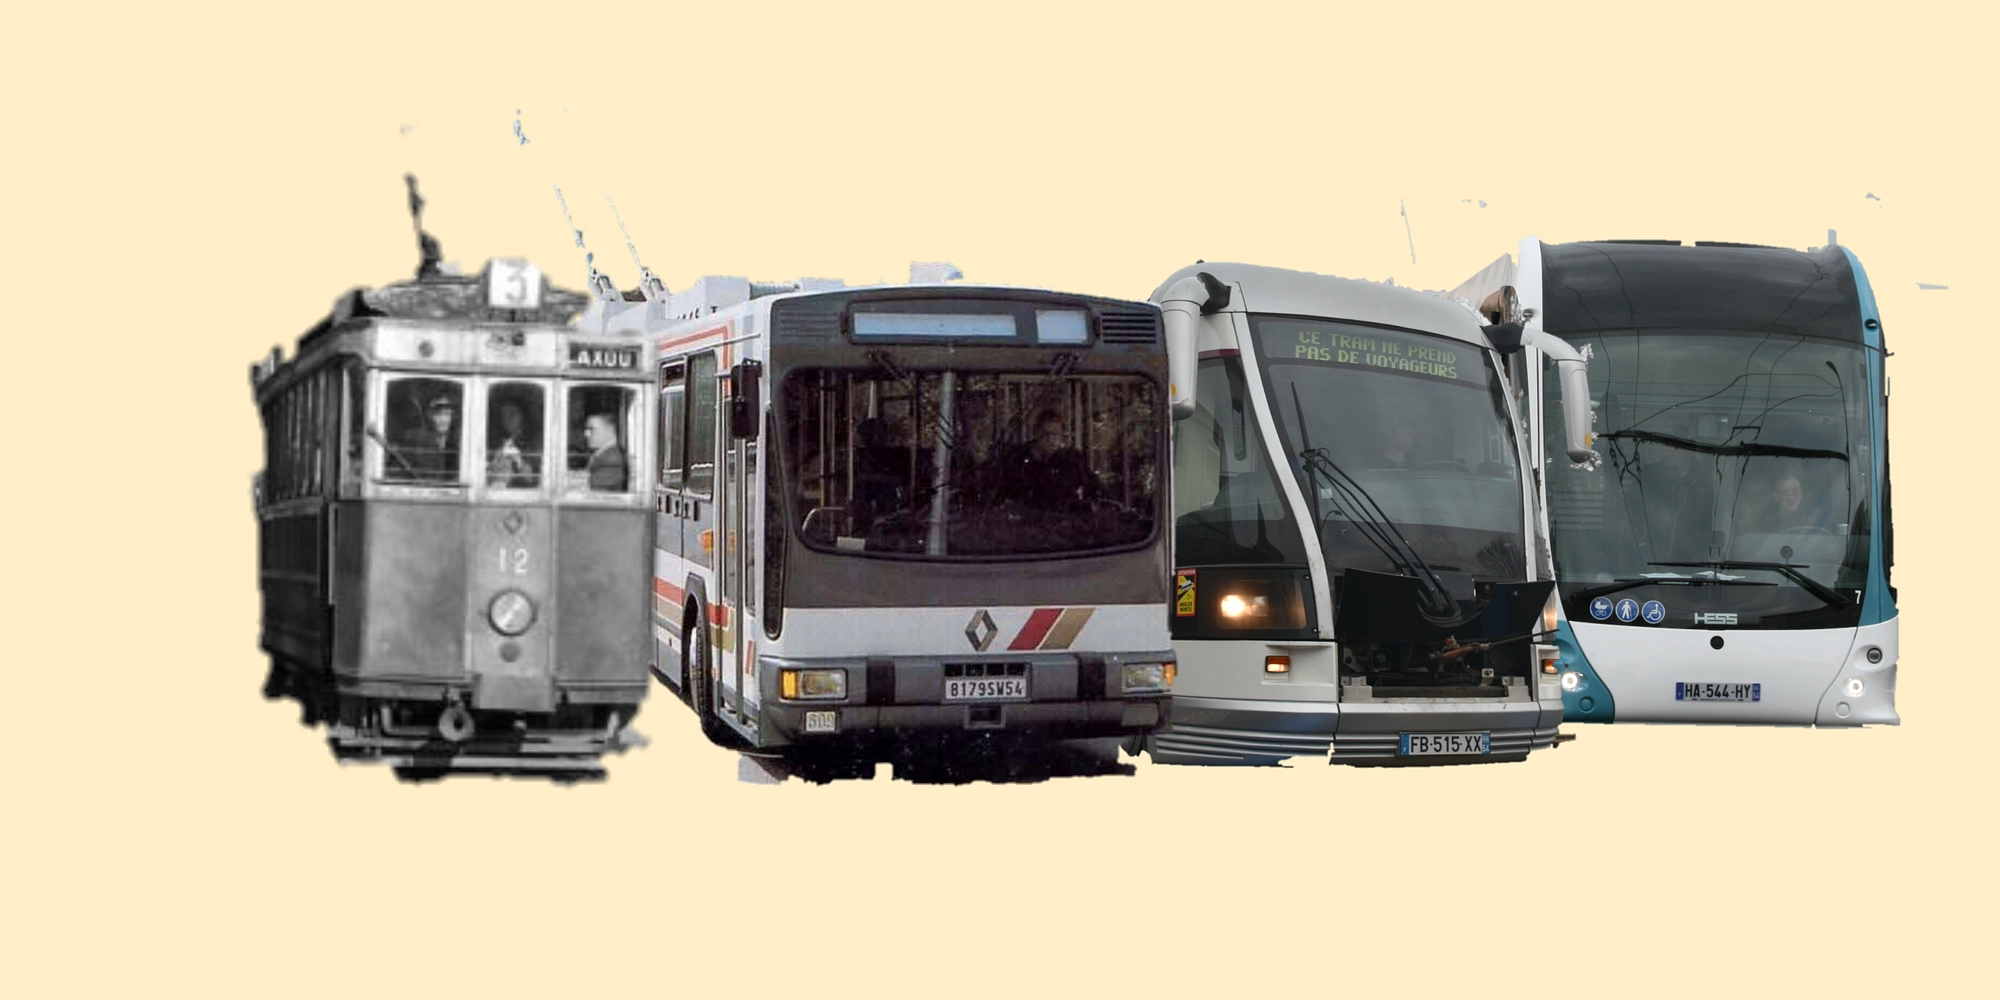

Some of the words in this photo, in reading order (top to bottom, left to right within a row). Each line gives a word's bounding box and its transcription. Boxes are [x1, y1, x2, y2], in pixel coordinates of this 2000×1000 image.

[505, 259, 528, 302] 3
[1329, 333, 1376, 351] TRAM
[1382, 341, 1402, 356] NE
[1408, 344, 1457, 364] PREND
[1295, 345, 1331, 362] PAS
[1338, 349, 1360, 364] DE
[1366, 353, 1458, 379] VOYAGEURS
[499, 546, 530, 574] 12
[1854, 589, 1862, 605] 7
[1694, 612, 1738, 625] HESS
[950, 681, 1022, 697] 8179SW54
[1685, 683, 1751, 698] HA-544-HY
[1411, 735, 1482, 753] FB-515-XX
